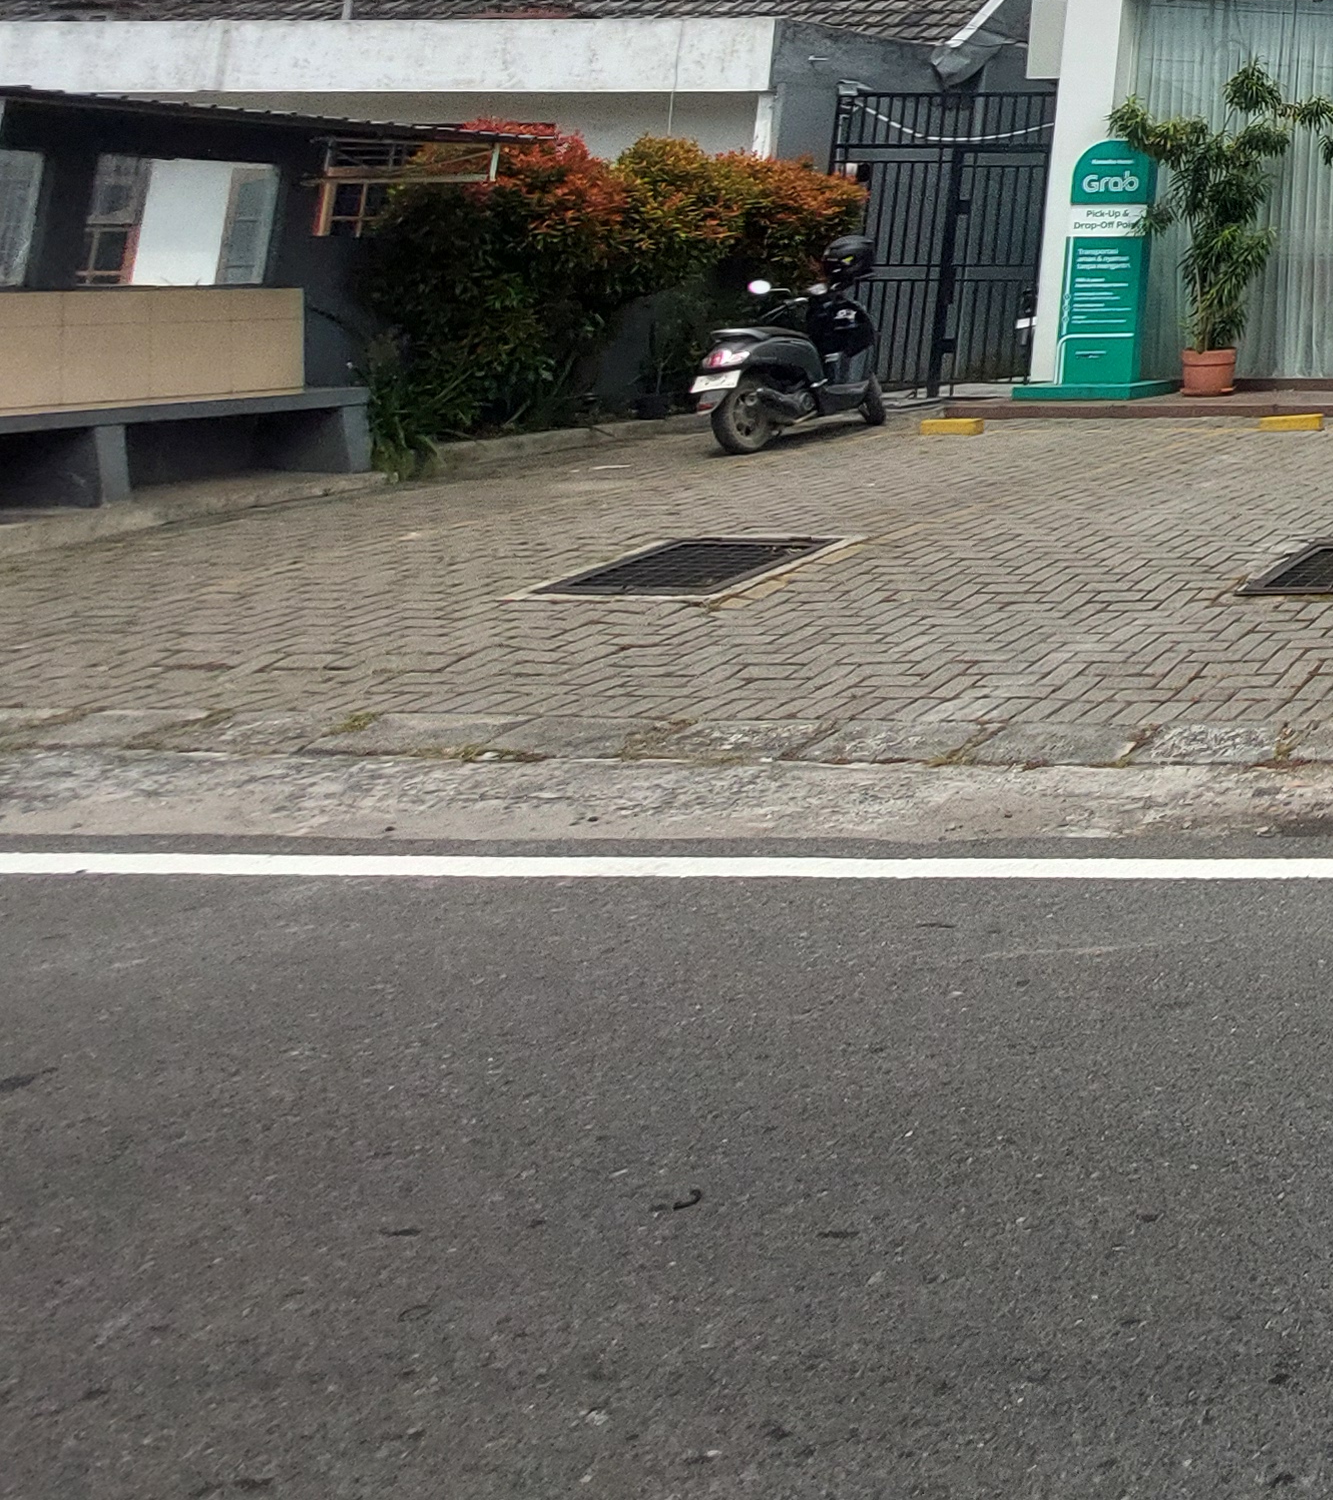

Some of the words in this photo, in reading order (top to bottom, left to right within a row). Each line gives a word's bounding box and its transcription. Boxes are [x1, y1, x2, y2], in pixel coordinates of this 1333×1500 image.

[1082, 170, 1139, 193] Grab
[1086, 210, 1120, 219] Pick-Up
[1074, 221, 1114, 230] Drop-Off
